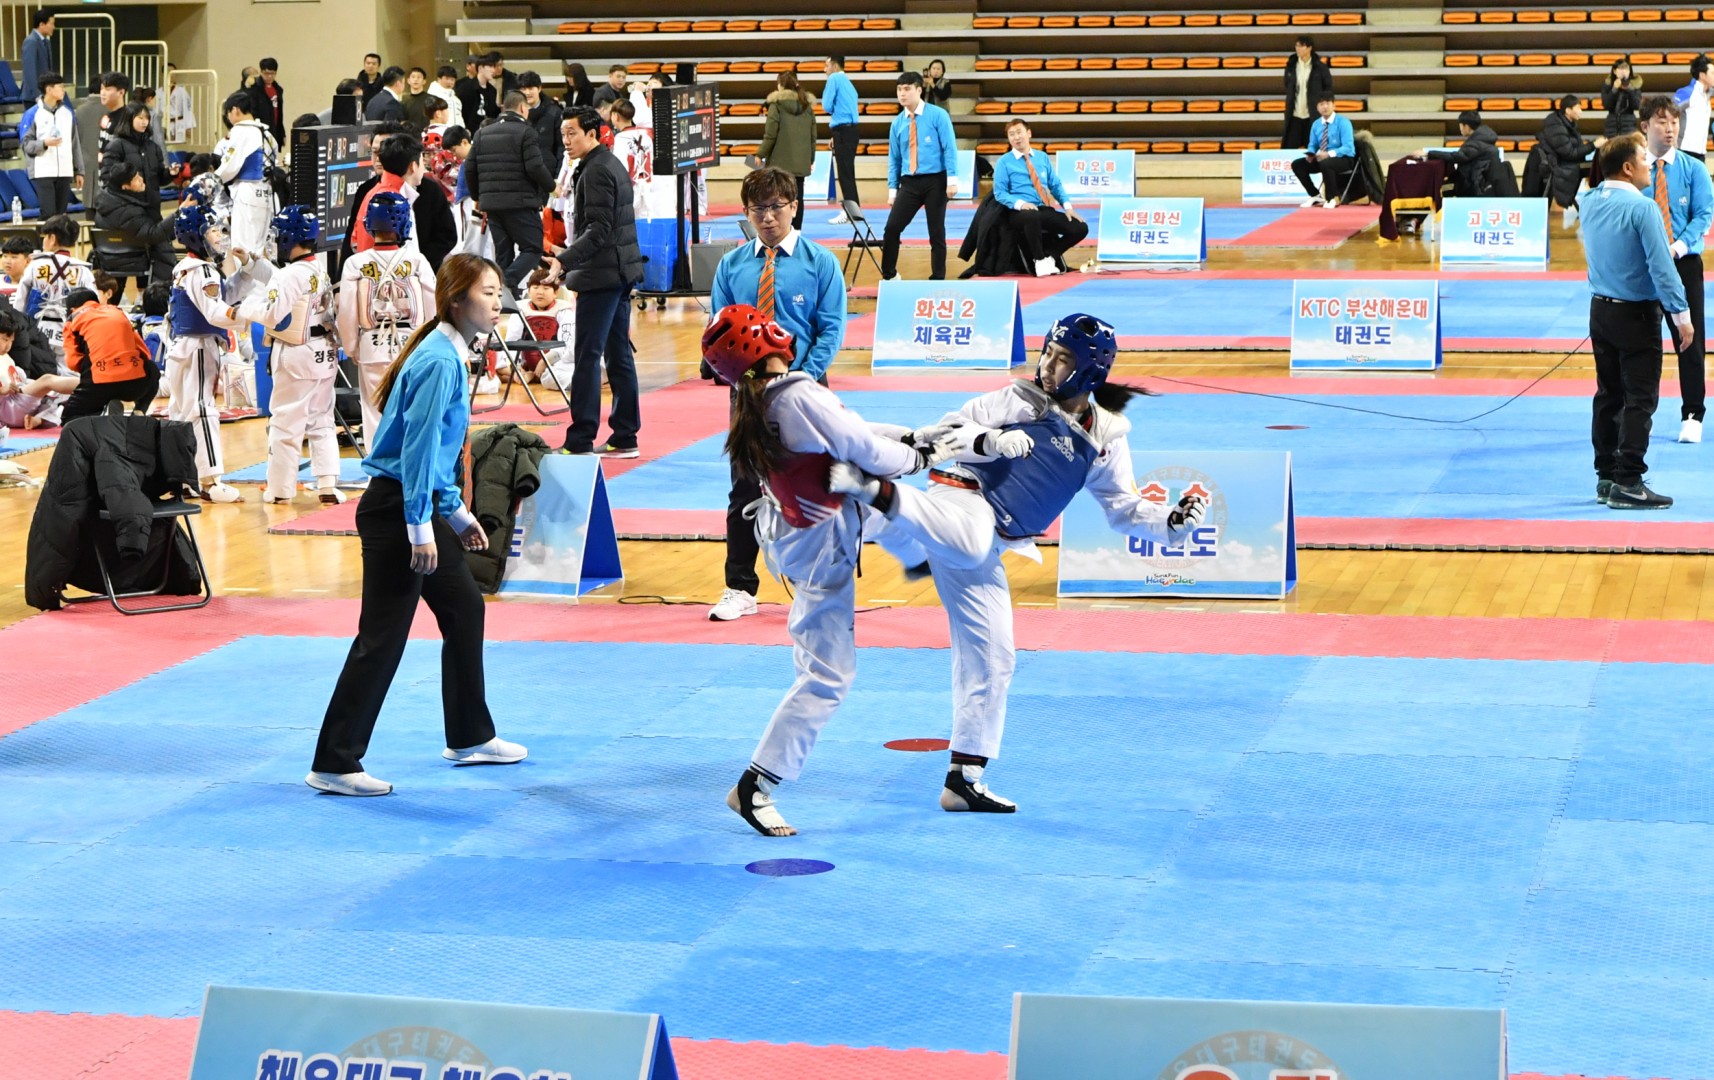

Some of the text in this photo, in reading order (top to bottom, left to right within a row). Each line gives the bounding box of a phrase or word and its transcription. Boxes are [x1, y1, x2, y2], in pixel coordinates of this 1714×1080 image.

[1080, 175, 1110, 186] 태권도
[1266, 174, 1298, 185] 태권도
[1122, 211, 1181, 225] 센텀 화신
[1469, 211, 1520, 226] 고구려
[1130, 230, 1169, 244] 태권도
[1473, 231, 1515, 246] 태권도
[915, 299, 975, 319] 화신 2
[1300, 299, 1428, 319] KTC 부산해운대
[914, 326, 972, 346] 체육관
[1335, 325, 1392, 345] 태권도
[1050, 436, 1075, 463] adidas
[1128, 527, 1217, 557] 태도
